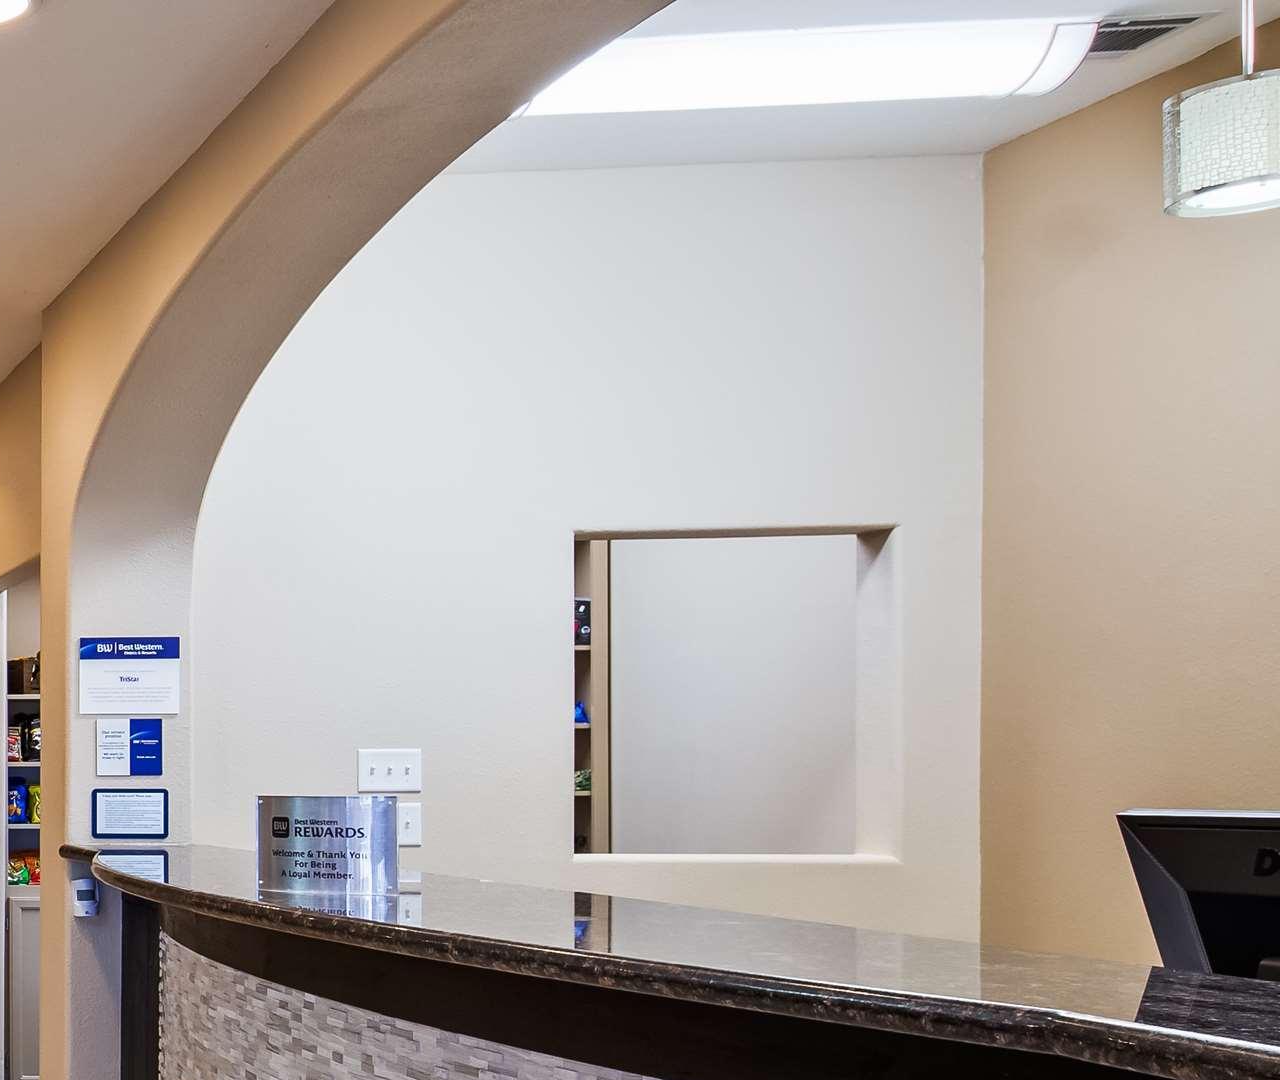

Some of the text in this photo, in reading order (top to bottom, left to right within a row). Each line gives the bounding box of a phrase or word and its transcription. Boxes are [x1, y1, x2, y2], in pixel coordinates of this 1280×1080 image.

[96, 643, 113, 653] BW
[118, 643, 133, 651] Best
[272, 849, 305, 858] Welcome
[307, 849, 314, 858] &
[316, 850, 346, 859] Thank
[294, 860, 337, 871] For Being
[281, 870, 287, 878] A
[288, 870, 311, 879] Loyal
